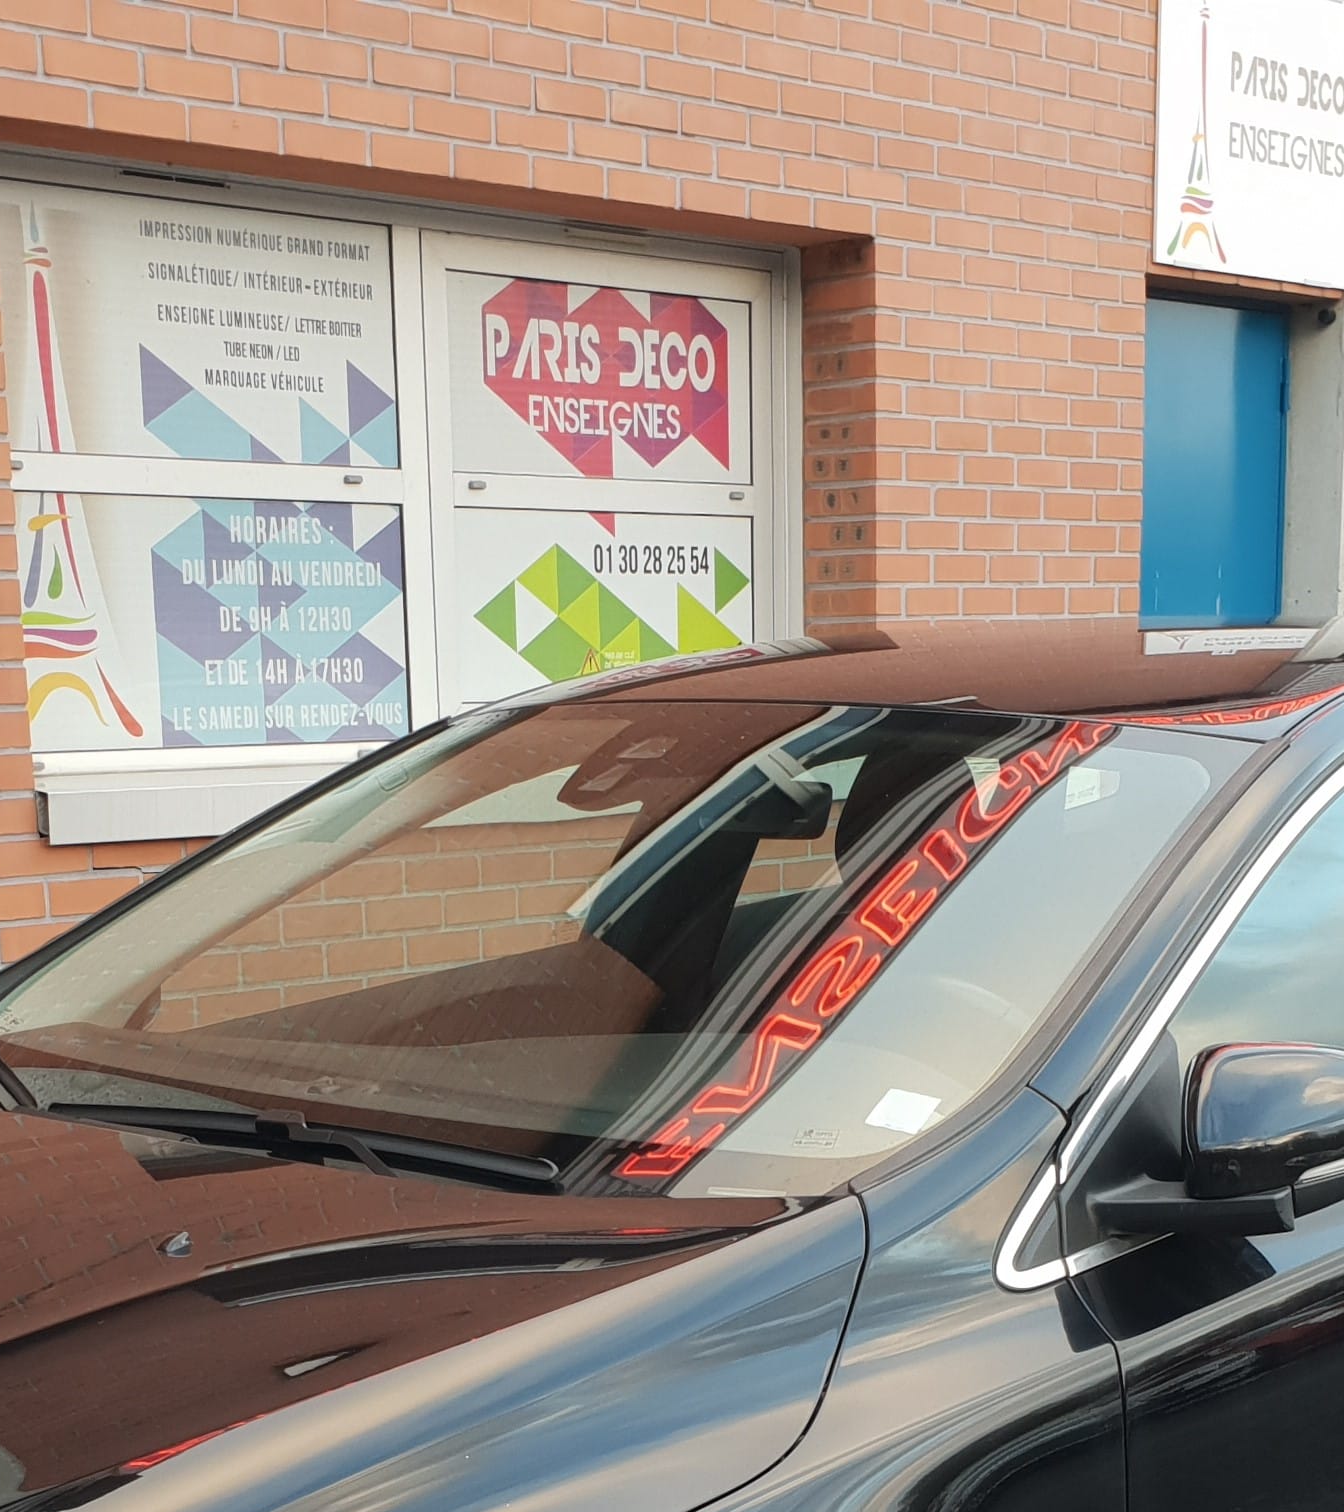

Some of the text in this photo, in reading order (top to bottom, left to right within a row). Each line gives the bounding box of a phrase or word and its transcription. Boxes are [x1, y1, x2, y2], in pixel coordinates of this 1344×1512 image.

[1230, 51, 1288, 103] PARIS
[1229, 121, 1344, 178] ENSEIGNES
[139, 219, 370, 262] IMPRESSION NUMÉRIQUE GRAND FORMAT
[158, 304, 215, 326] ENSEIGNE
[295, 317, 327, 335] LETTRE
[329, 320, 362, 338] BOITIER
[224, 341, 248, 359] TUBE
[249, 343, 273, 360] NEON
[283, 345, 300, 362] LED
[485, 313, 716, 393] PARIS DECO
[205, 368, 324, 393] MARQUAGE VÉHICULE
[528, 394, 681, 440] ENSEIGNES
[230, 515, 322, 544] HORAIRES
[182, 559, 382, 587] DU LUNDI AU VENDREDI
[593, 543, 709, 575] 01 30 28 25 54
[220, 601, 352, 632] DE 9H À 12H30
[205, 653, 364, 686] ET DE 14H À 17H30
[173, 702, 403, 731] LE SAMEDI SUR RENDEZ-VOUS
